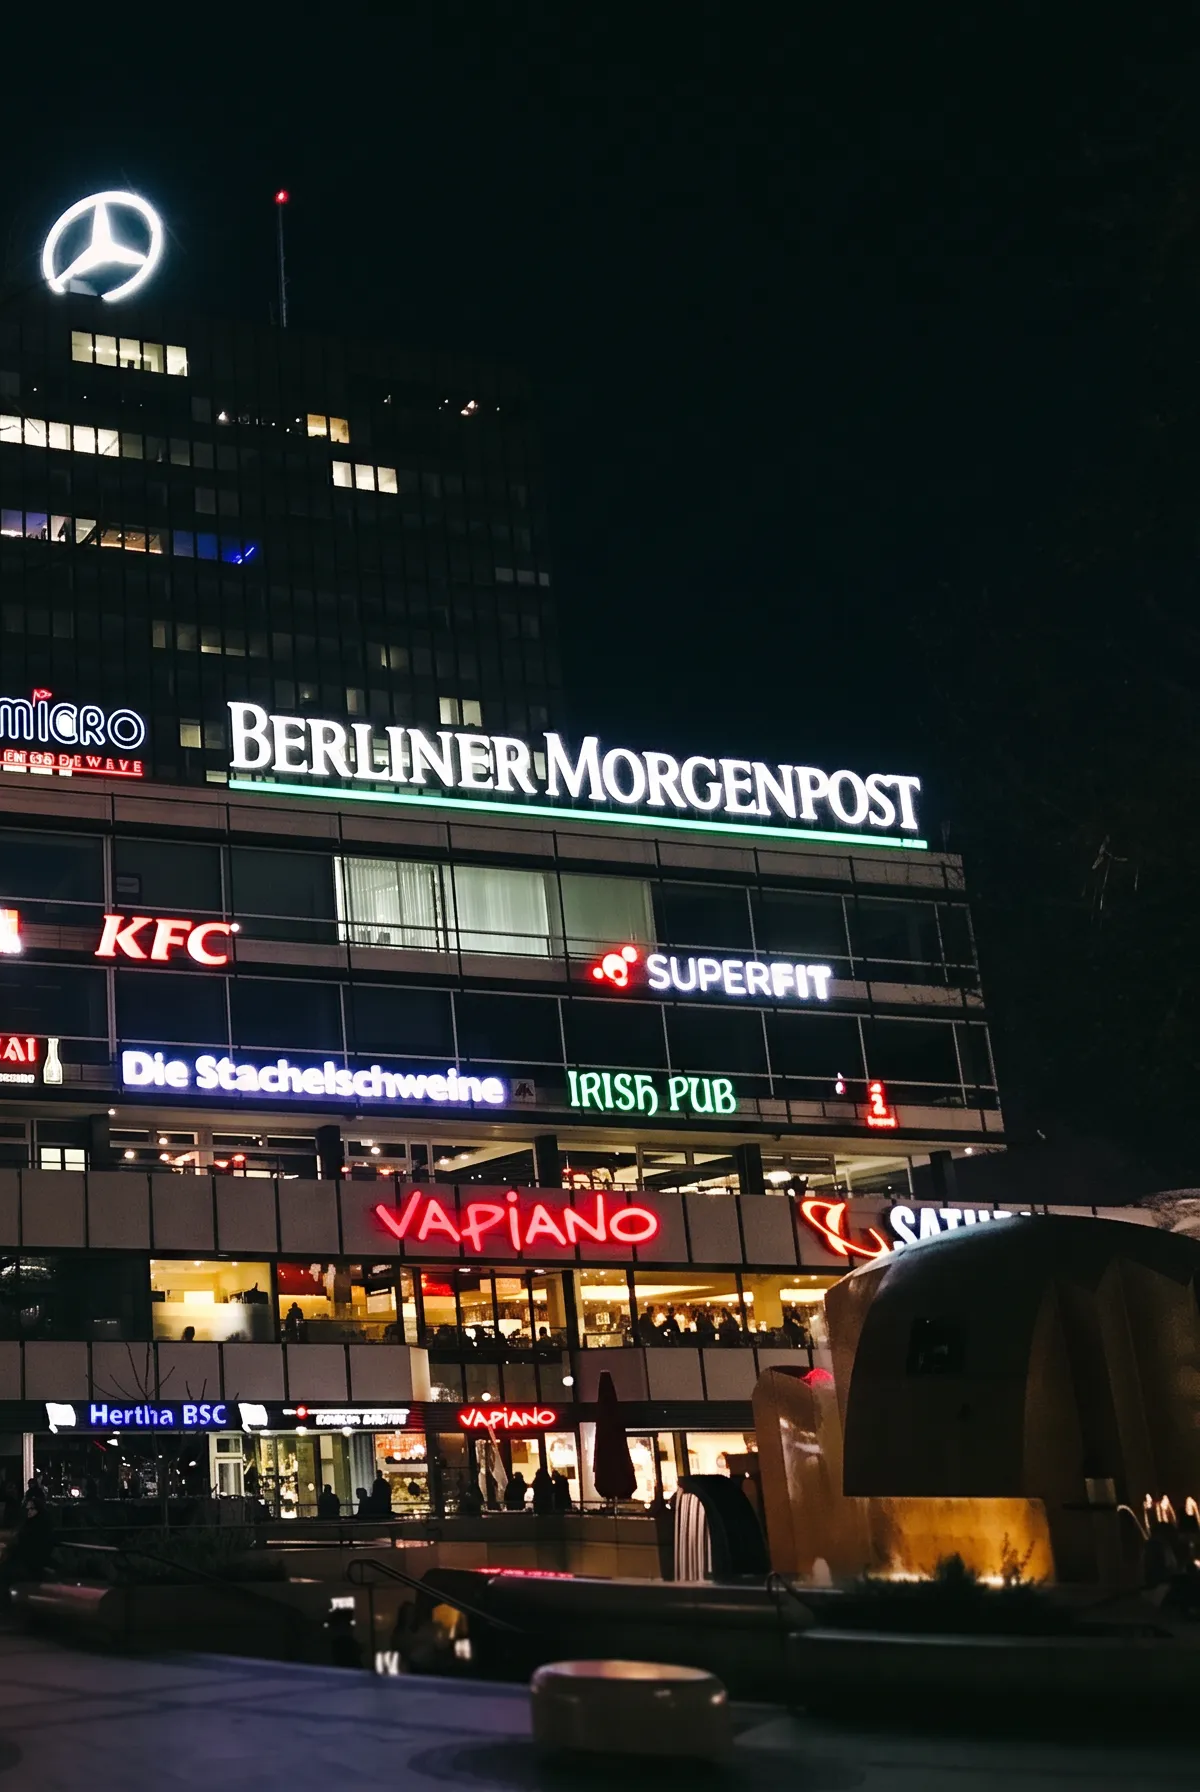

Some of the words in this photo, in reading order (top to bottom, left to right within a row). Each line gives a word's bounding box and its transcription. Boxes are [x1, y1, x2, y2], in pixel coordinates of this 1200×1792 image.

[227, 701, 538, 795] BERLINER
[544, 732, 921, 830] MORGENPOST
[95, 913, 233, 966] KFC
[646, 953, 832, 1000] SUPERFIT
[122, 1050, 189, 1088] Die
[195, 1055, 506, 1104] Stachelschweine
[668, 1076, 737, 1114] PUB
[90, 1403, 175, 1426] Hertha
[182, 1404, 227, 1426] BSC
